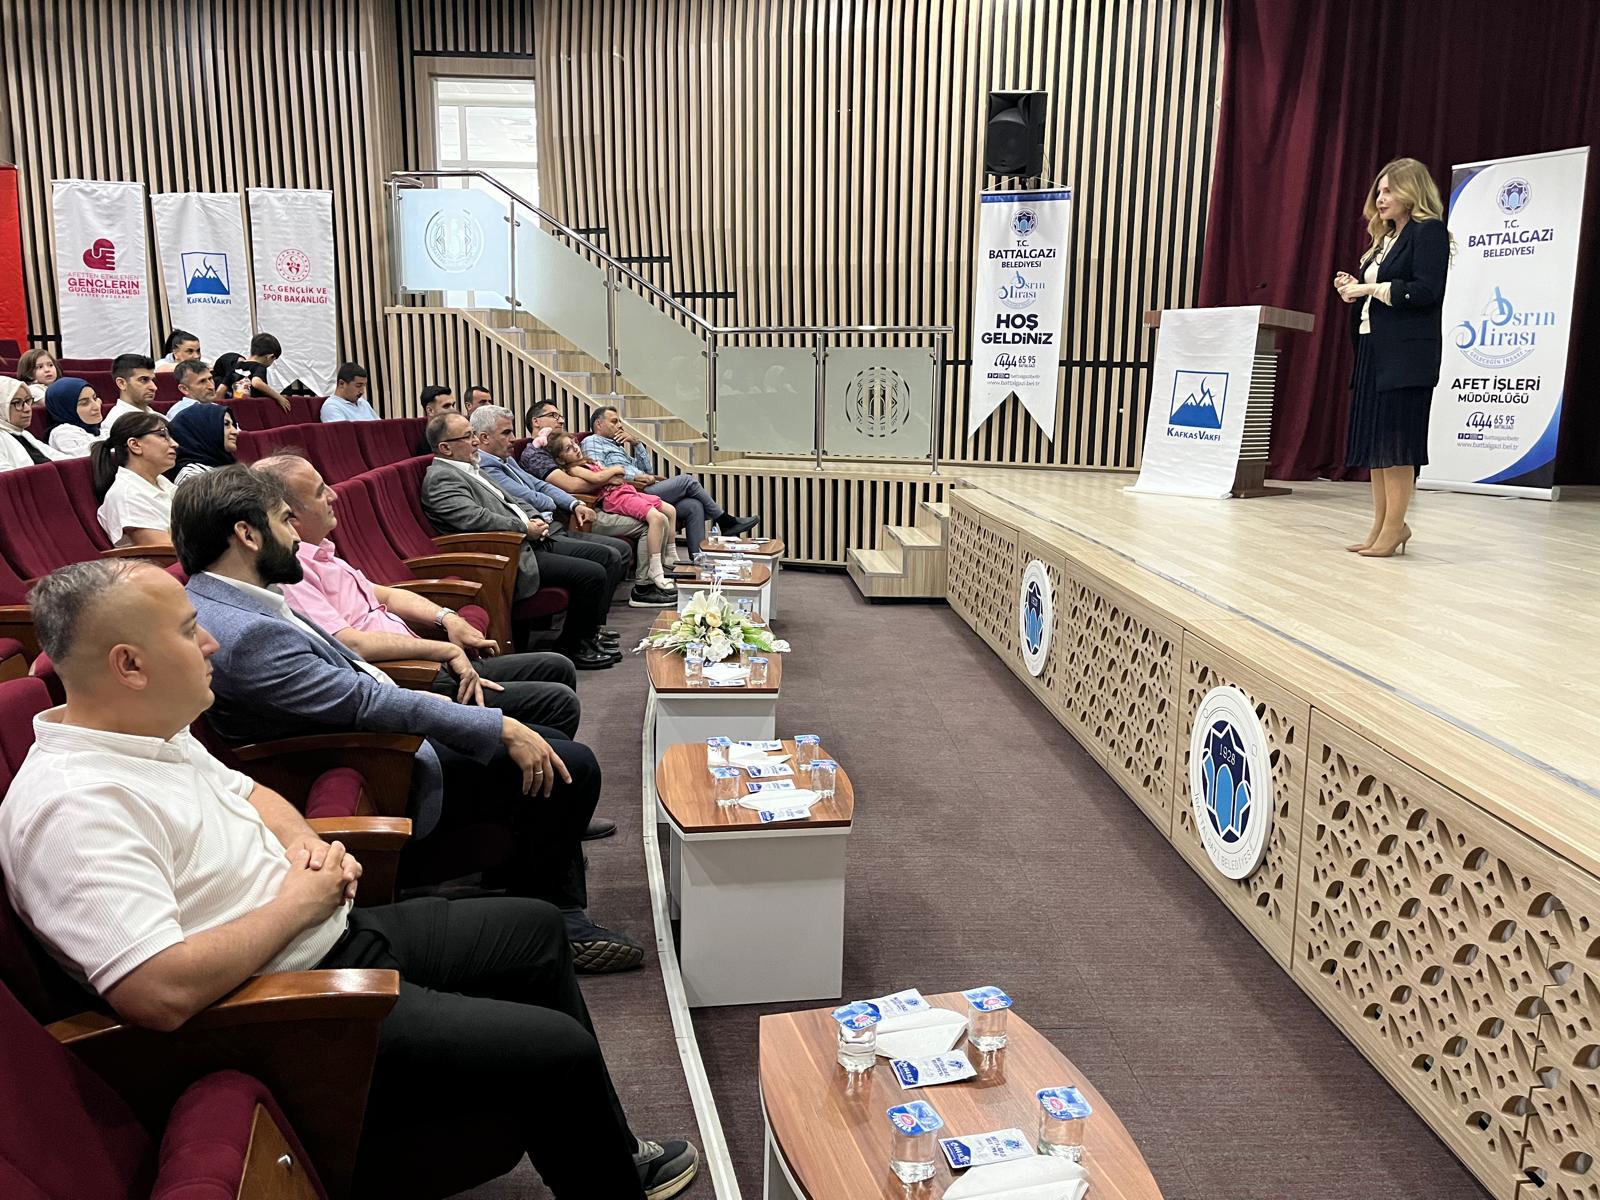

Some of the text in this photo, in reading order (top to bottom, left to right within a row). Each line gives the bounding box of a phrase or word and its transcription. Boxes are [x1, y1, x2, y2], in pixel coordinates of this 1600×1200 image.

[1503, 219, 1519, 229] T.C.
[1016, 239, 1029, 247] T.C.
[263, 293, 282, 301] SPOR
[996, 313, 1039, 331] HOŞ
[997, 354, 1017, 369] 444
[1451, 375, 1541, 392] AFET İŞLERİ
[1457, 391, 1529, 404] MÜDÜRLÜĞÜ
[1469, 413, 1492, 430] 444
[1494, 414, 1503, 425] 65
[1505, 415, 1515, 425] 95
[1219, 743, 1236, 766] 1928
